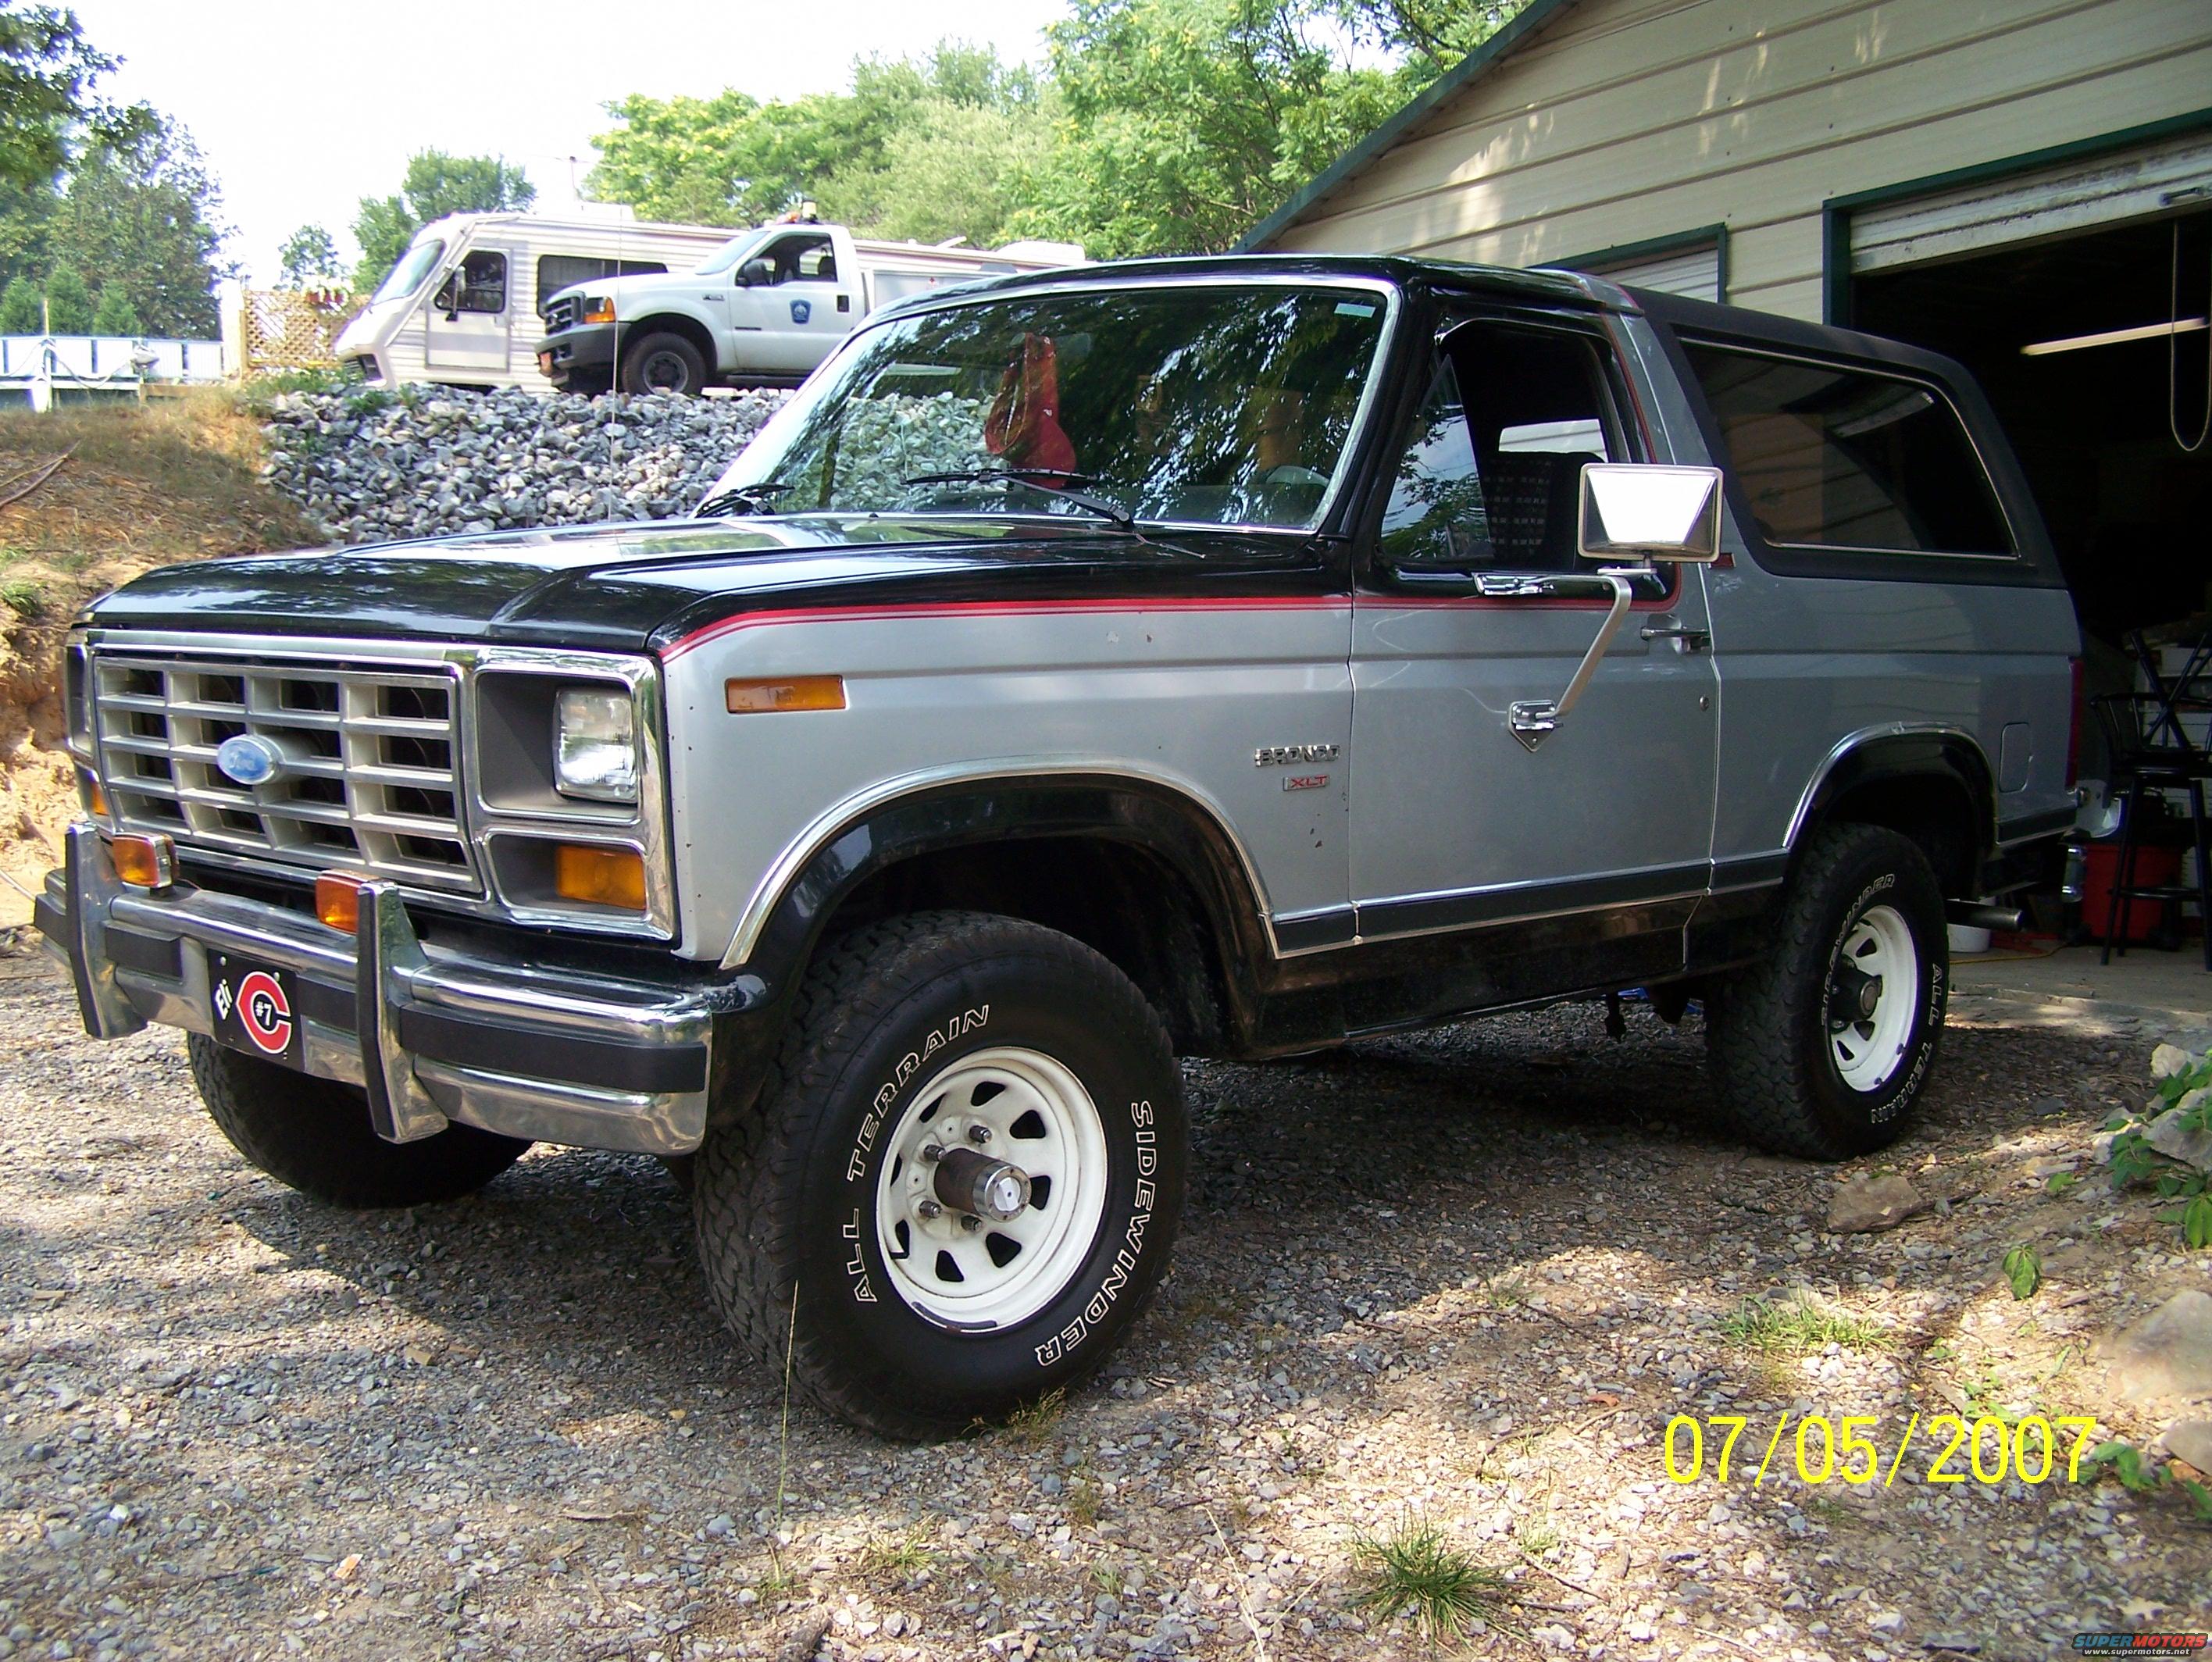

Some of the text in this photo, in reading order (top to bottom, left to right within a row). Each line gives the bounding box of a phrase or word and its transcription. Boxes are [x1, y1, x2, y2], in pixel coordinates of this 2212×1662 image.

[1254, 744, 1340, 767] BRONCO
[1290, 775, 1328, 788] XLT
[255, 1001, 272, 1026] #7
[1928, 962, 1943, 1027] ALL
[843, 1004, 990, 1303] ALL TERRAIN
[1033, 1100, 1157, 1367] SIDEWINDER
